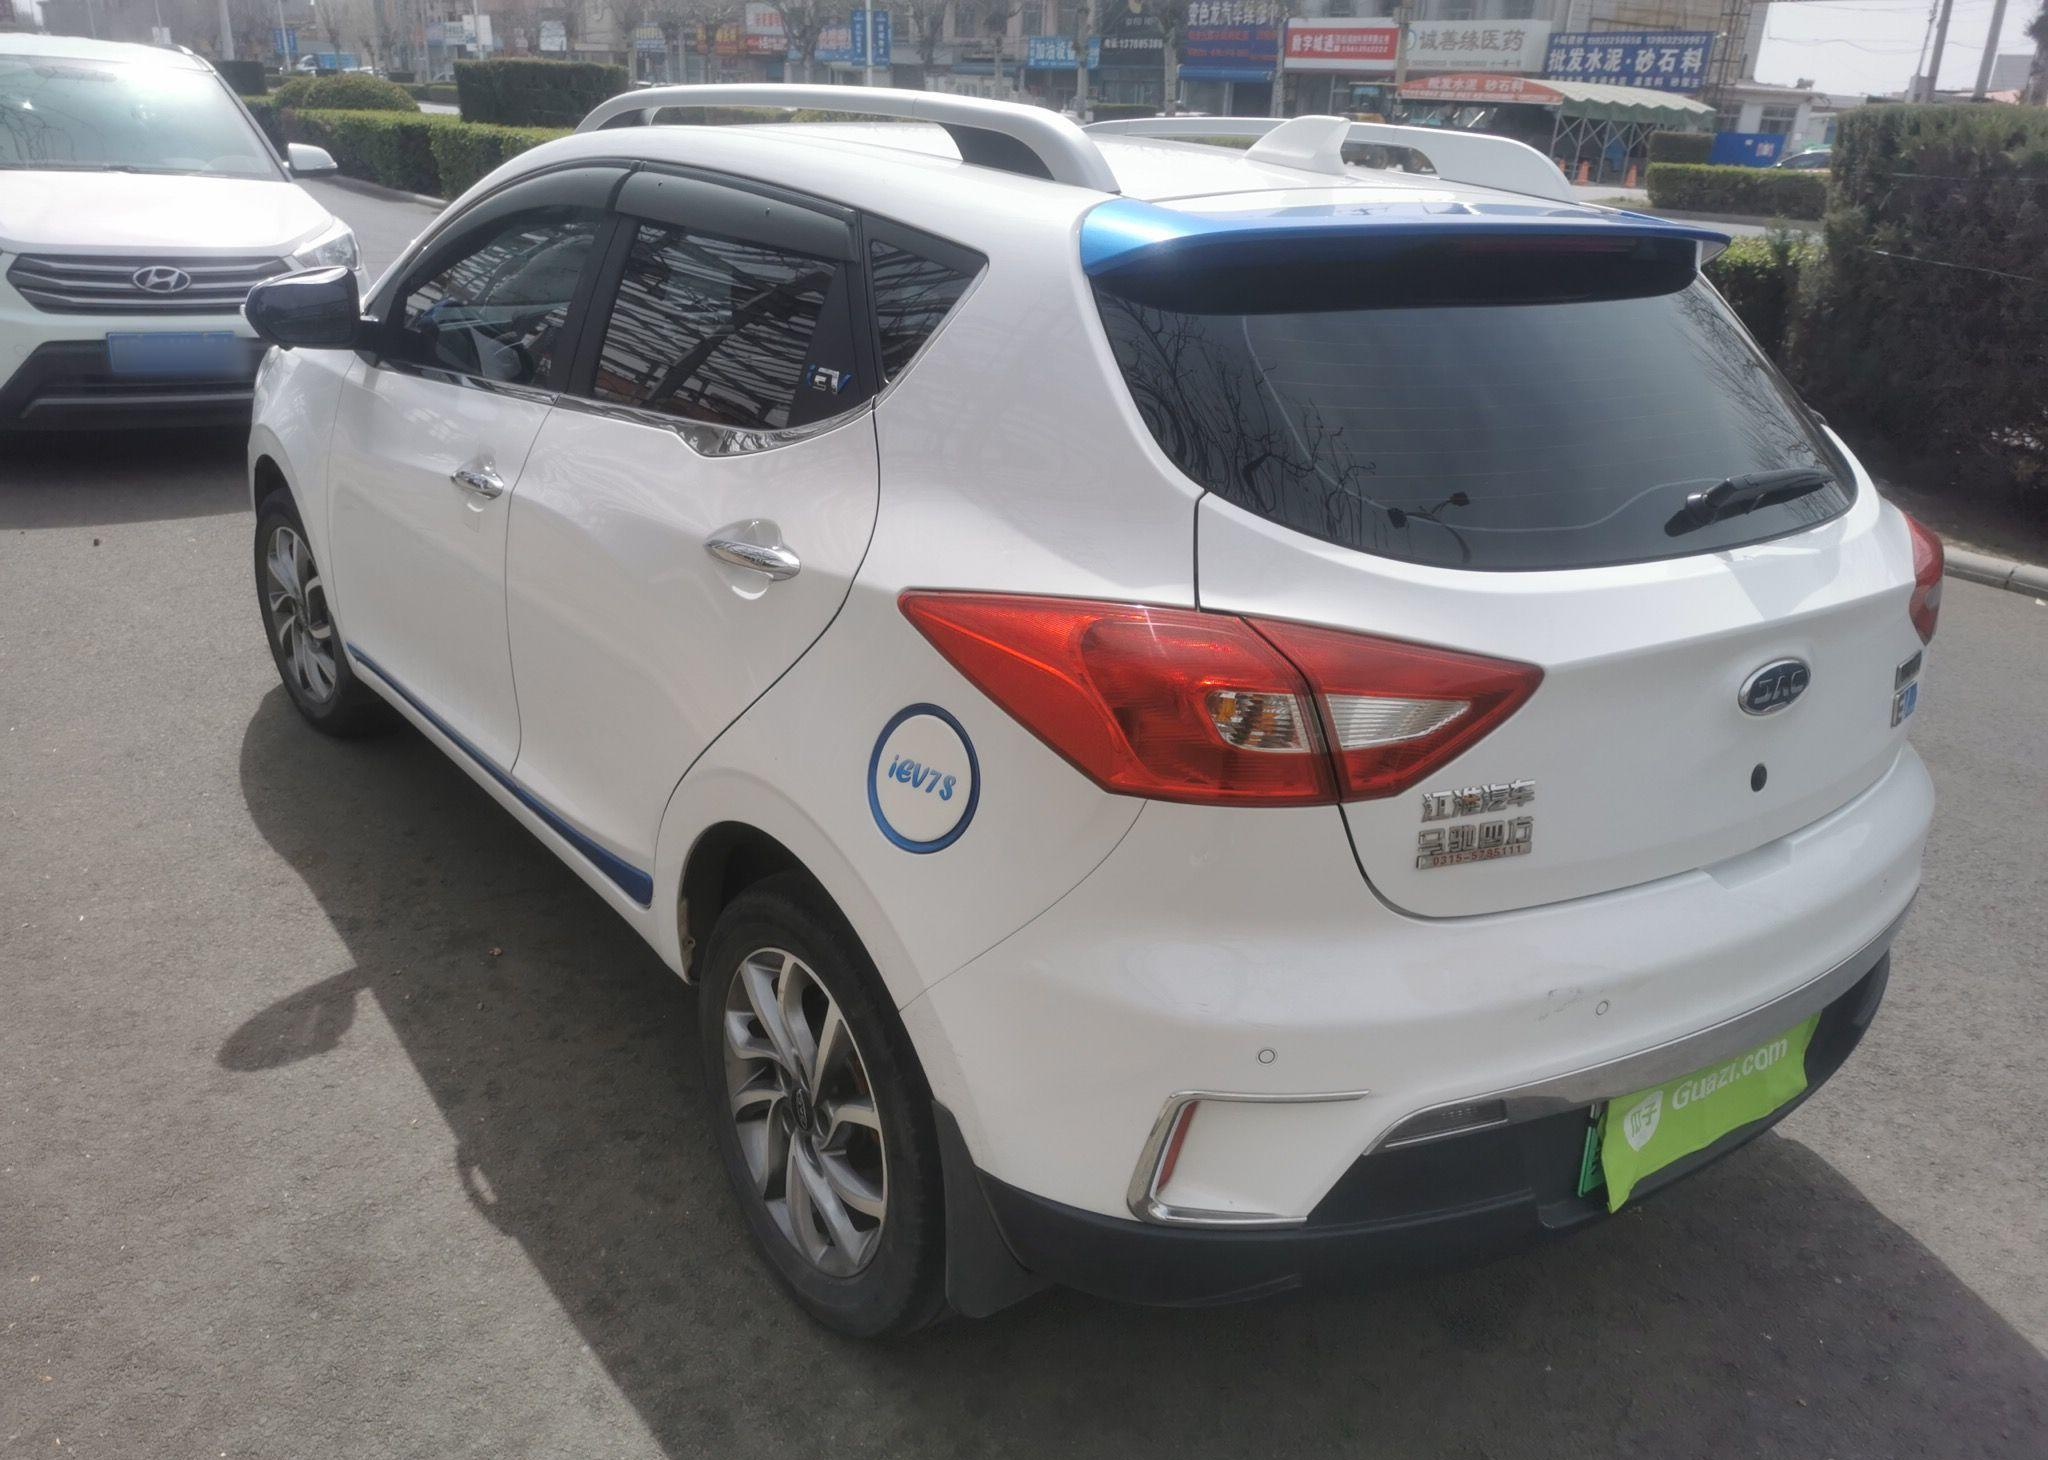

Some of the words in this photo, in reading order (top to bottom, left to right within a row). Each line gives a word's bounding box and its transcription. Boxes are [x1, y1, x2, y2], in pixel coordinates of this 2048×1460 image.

[1419, 30, 1525, 51] 诚善缘医药
[1421, 779, 1536, 822] 江淮汽车
[1671, 1038, 1788, 1110] Guazi.com
